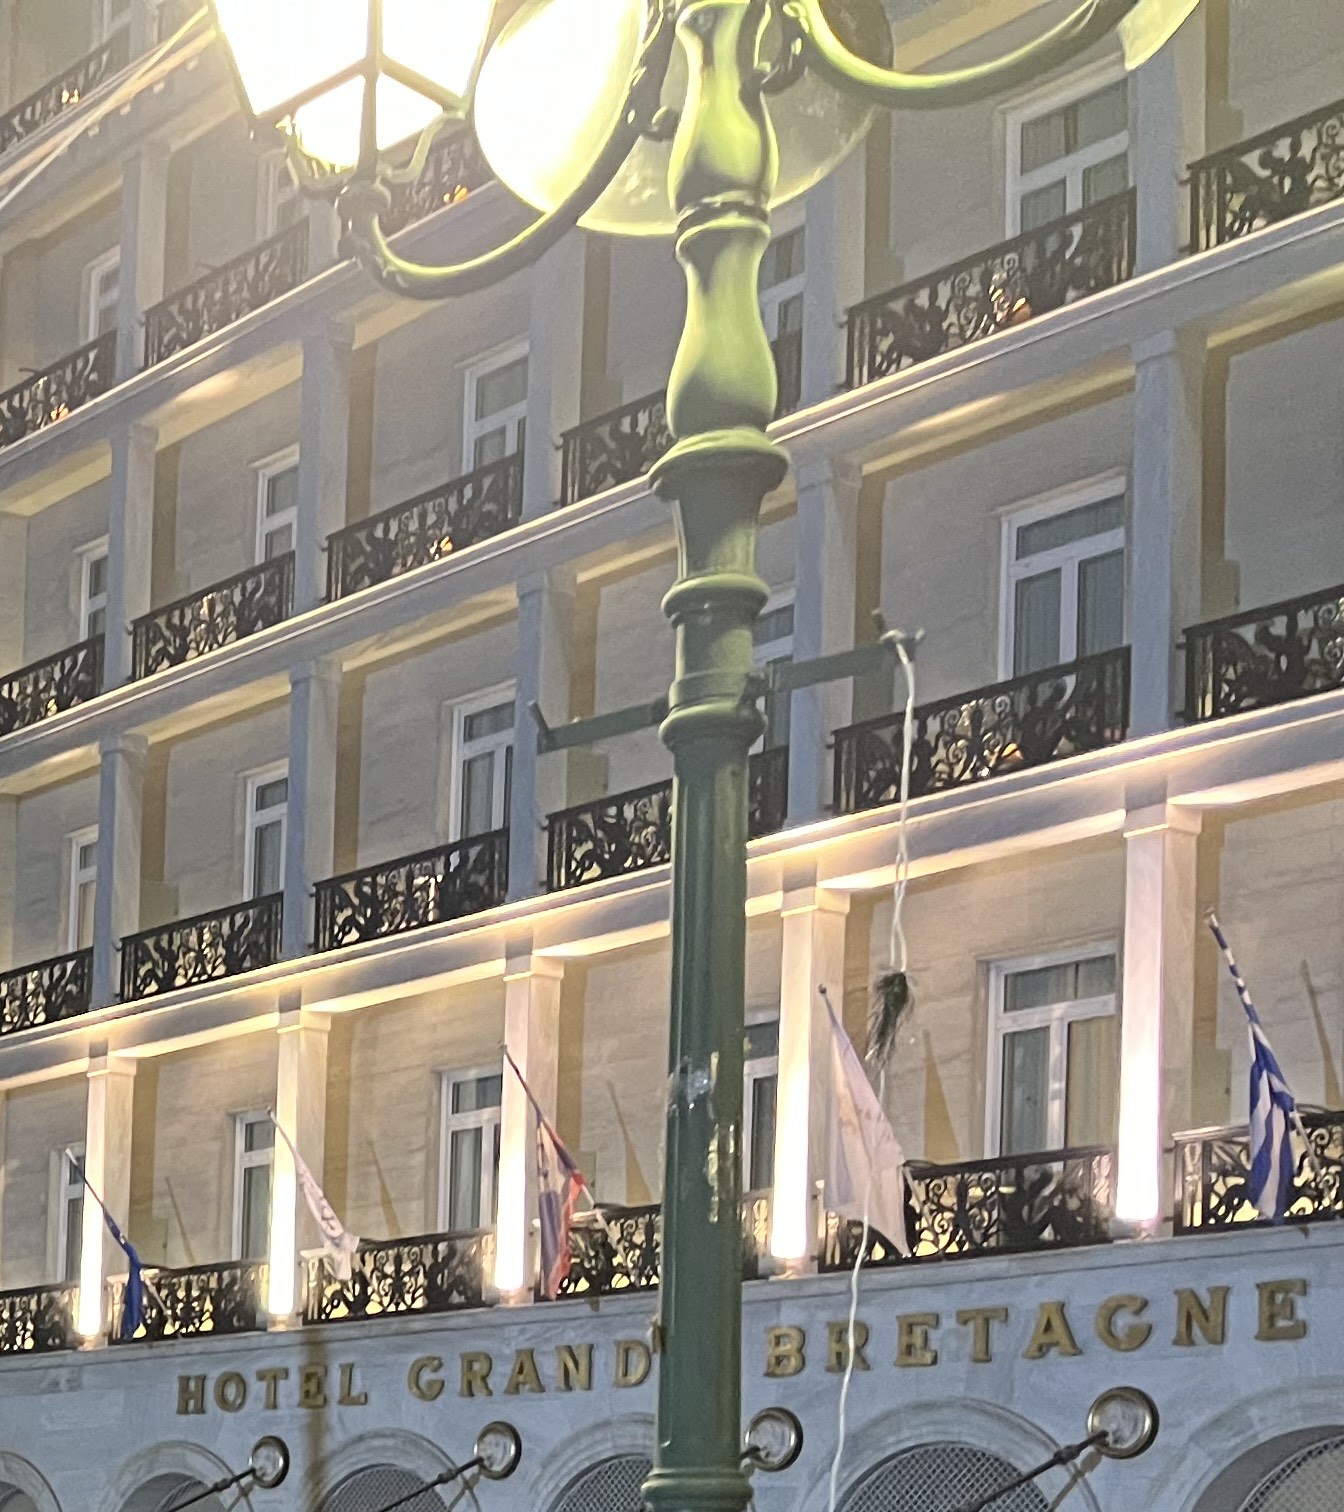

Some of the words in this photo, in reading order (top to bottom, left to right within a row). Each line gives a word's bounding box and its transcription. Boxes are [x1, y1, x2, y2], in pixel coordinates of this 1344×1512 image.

[177, 1361, 368, 1414] HOTEL
[408, 1341, 652, 1400] GRAND
[764, 1278, 1307, 1379] BRETAGNE
